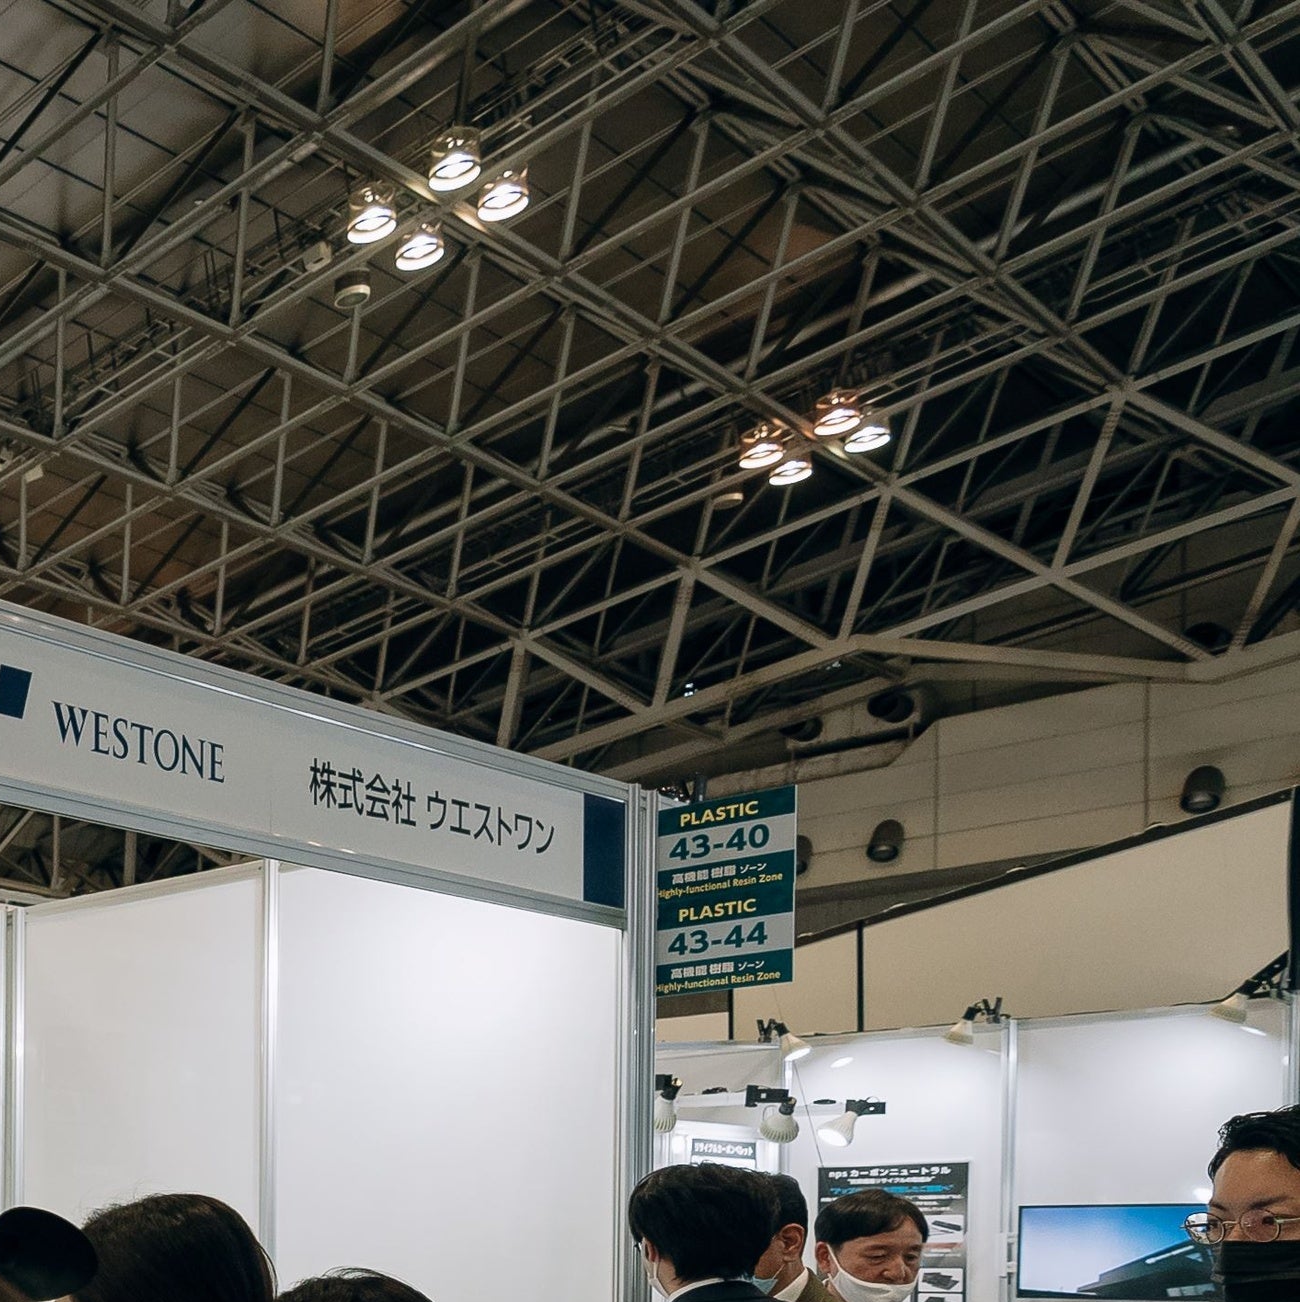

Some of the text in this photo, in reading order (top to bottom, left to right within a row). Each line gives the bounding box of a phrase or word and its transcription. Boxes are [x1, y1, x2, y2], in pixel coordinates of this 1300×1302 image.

[51, 700, 225, 783] WESTONE
[308, 757, 555, 854] 株式会社 ウエストワン
[680, 801, 759, 827] PLASTIC
[669, 823, 770, 861] 43-40
[733, 876, 757, 887] Resin
[759, 872, 783, 883] Zone
[678, 898, 757, 922] PLASTIC
[668, 921, 768, 956] 43-44
[731, 972, 755, 984] Resin
[757, 970, 781, 980] Zone
